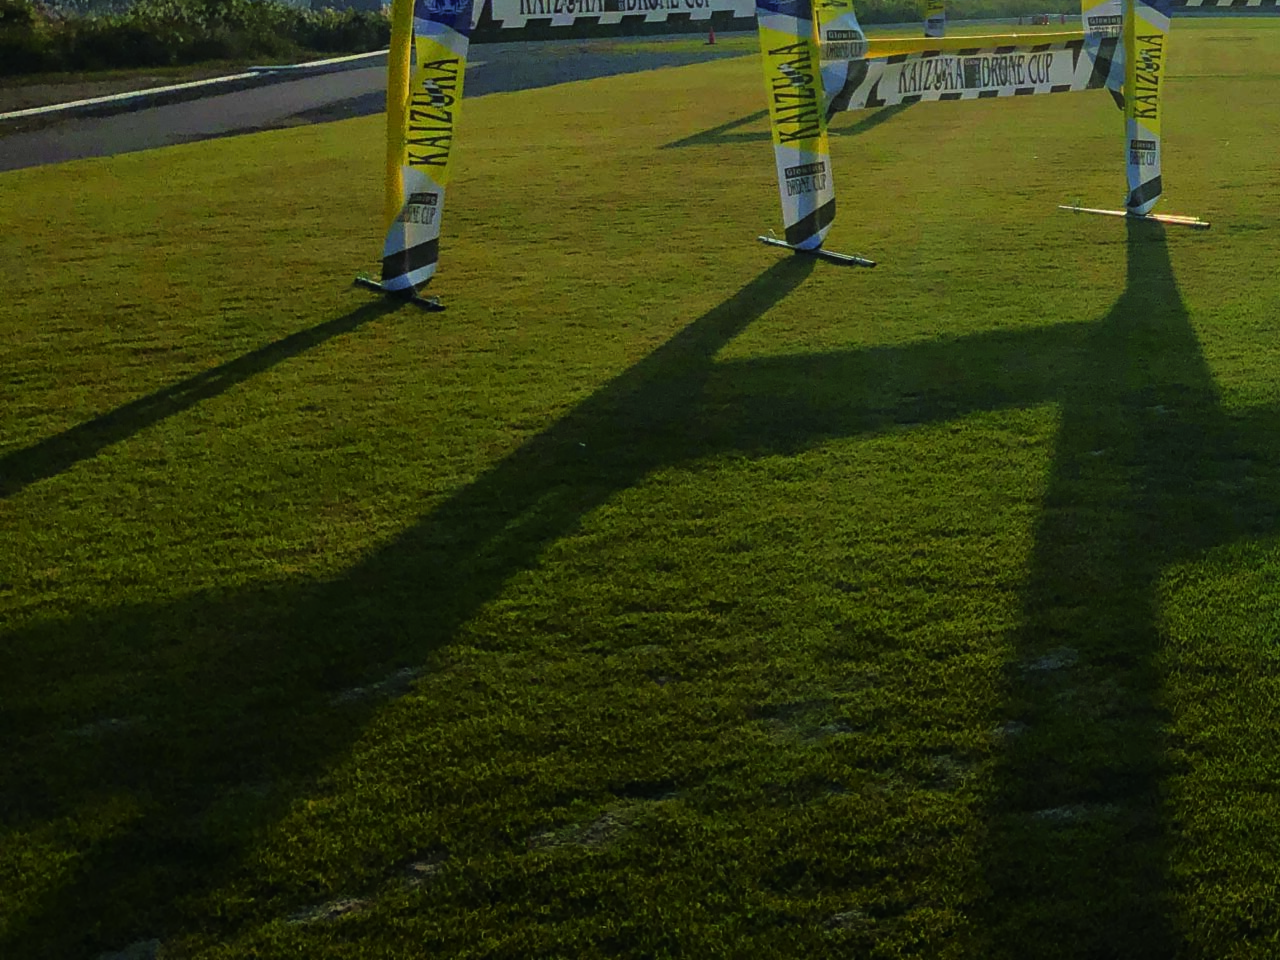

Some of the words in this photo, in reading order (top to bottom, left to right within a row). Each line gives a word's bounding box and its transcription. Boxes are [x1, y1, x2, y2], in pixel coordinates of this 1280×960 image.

[408, 58, 459, 167] KAIZUKA
[767, 40, 821, 144] KAIZUKA
[898, 58, 964, 94] KAIZUKA
[981, 54, 1025, 87] DRONE
[1027, 53, 1053, 84] CUP
[1134, 33, 1164, 120] KAIZUKA
